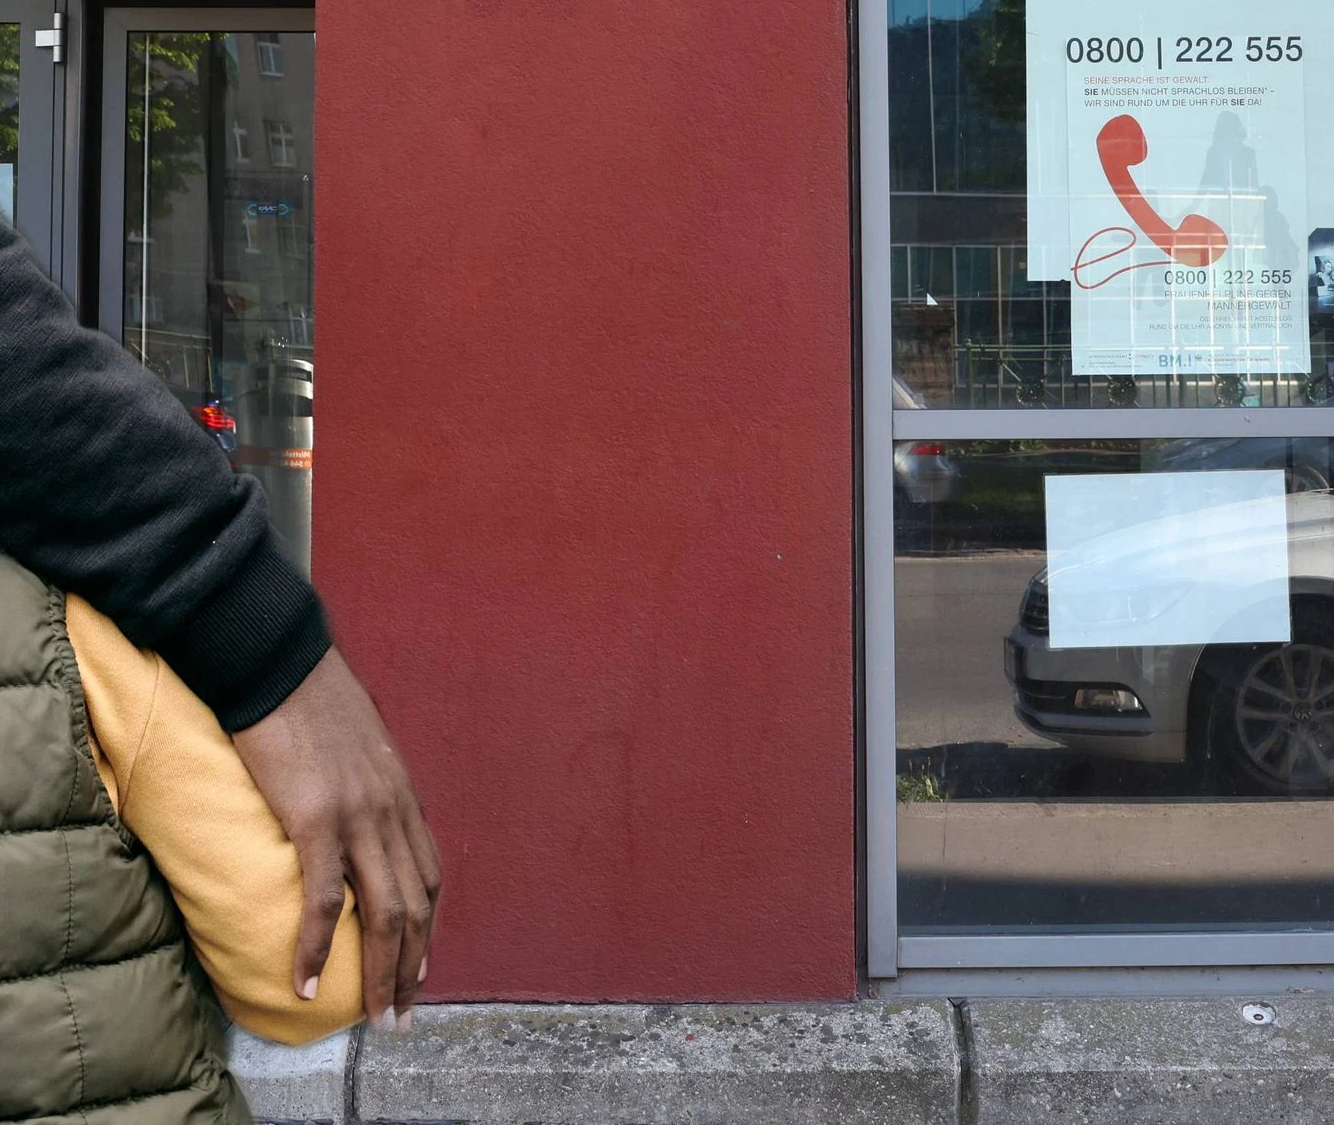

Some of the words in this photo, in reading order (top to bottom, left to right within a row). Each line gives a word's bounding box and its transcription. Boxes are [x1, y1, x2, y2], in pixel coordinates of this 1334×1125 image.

[1066, 37, 1144, 63] 0800
[1175, 36, 1233, 63] 222
[1245, 36, 1303, 62] 555
[1083, 76, 1110, 85] SEINE
[1112, 76, 1154, 85] SPRACHE
[1156, 76, 1170, 84] IST
[1084, 88, 1099, 96] SIE
[1101, 86, 1139, 96] MÜSSEN
[1142, 87, 1169, 95] NICHT
[1171, 87, 1225, 95] SPRACHLOS
[1084, 99, 1102, 107] WIR
[1104, 99, 1125, 107] SIND
[1128, 99, 1153, 107] RUND
[1156, 99, 1170, 107] UM
[1172, 99, 1186, 107] DIE
[1189, 99, 1208, 107] UHR
[1210, 97, 1228, 107] FÜR
[1230, 98, 1245, 106] SIE
[1247, 98, 1262, 106] DA!
[1164, 270, 1207, 285] 0800
[1223, 270, 1254, 285] 222
[1260, 269, 1292, 284] 555
[1256, 289, 1292, 298] GEGEN
